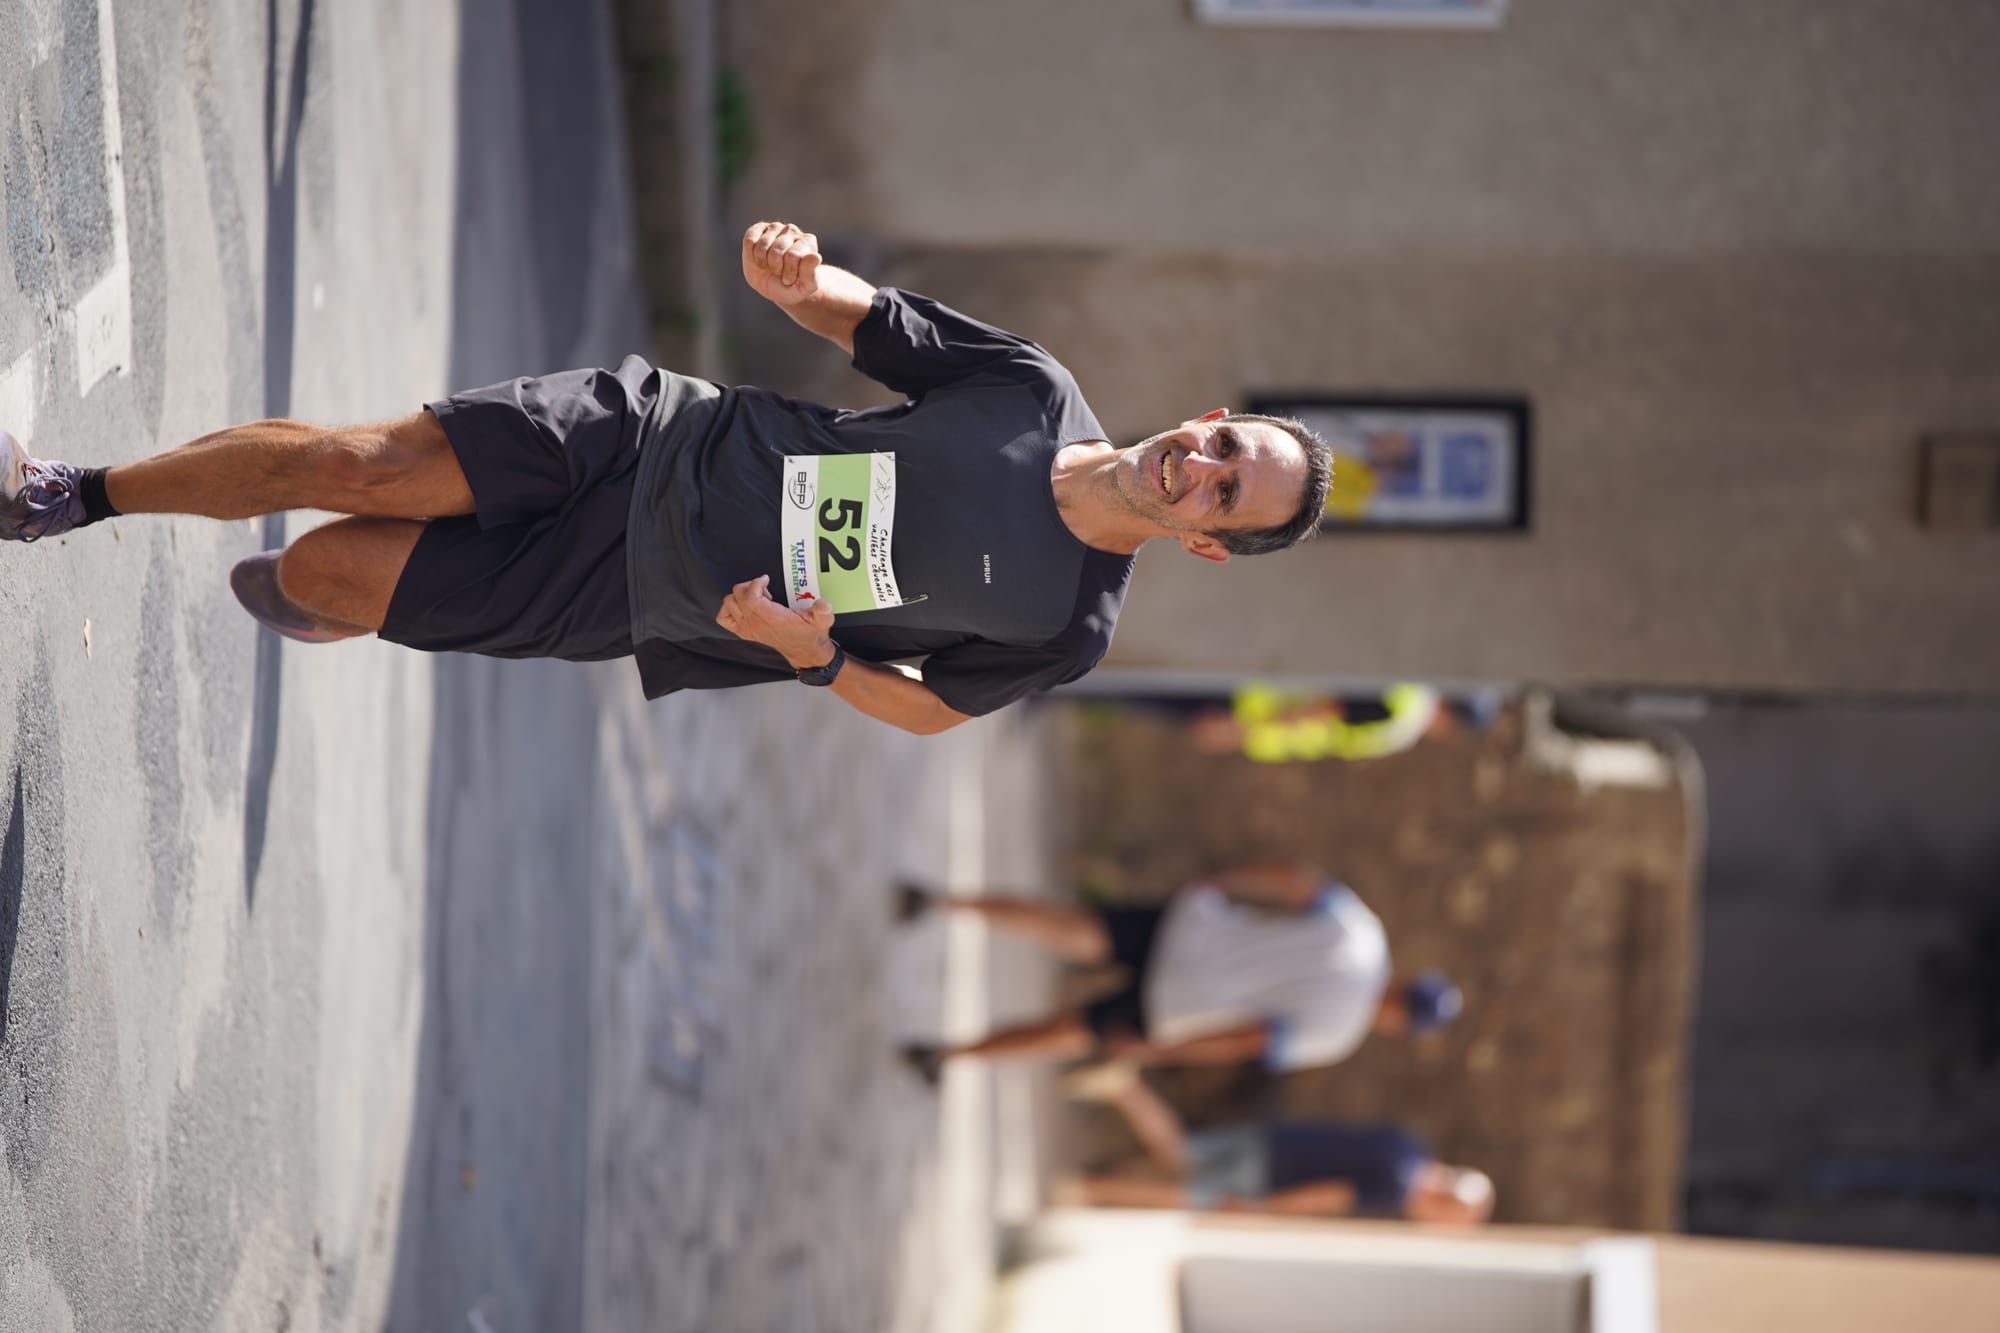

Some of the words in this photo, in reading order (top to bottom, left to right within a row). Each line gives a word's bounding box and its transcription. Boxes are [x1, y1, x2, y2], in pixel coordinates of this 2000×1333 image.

[797, 472, 807, 505] BFP
[818, 498, 863, 573] 52
[790, 544, 800, 592] Aventure
[796, 539, 808, 587] TUFF'S
[879, 528, 888, 578] Challenge
[886, 582, 895, 597] des
[983, 554, 992, 584] KIPRUN
